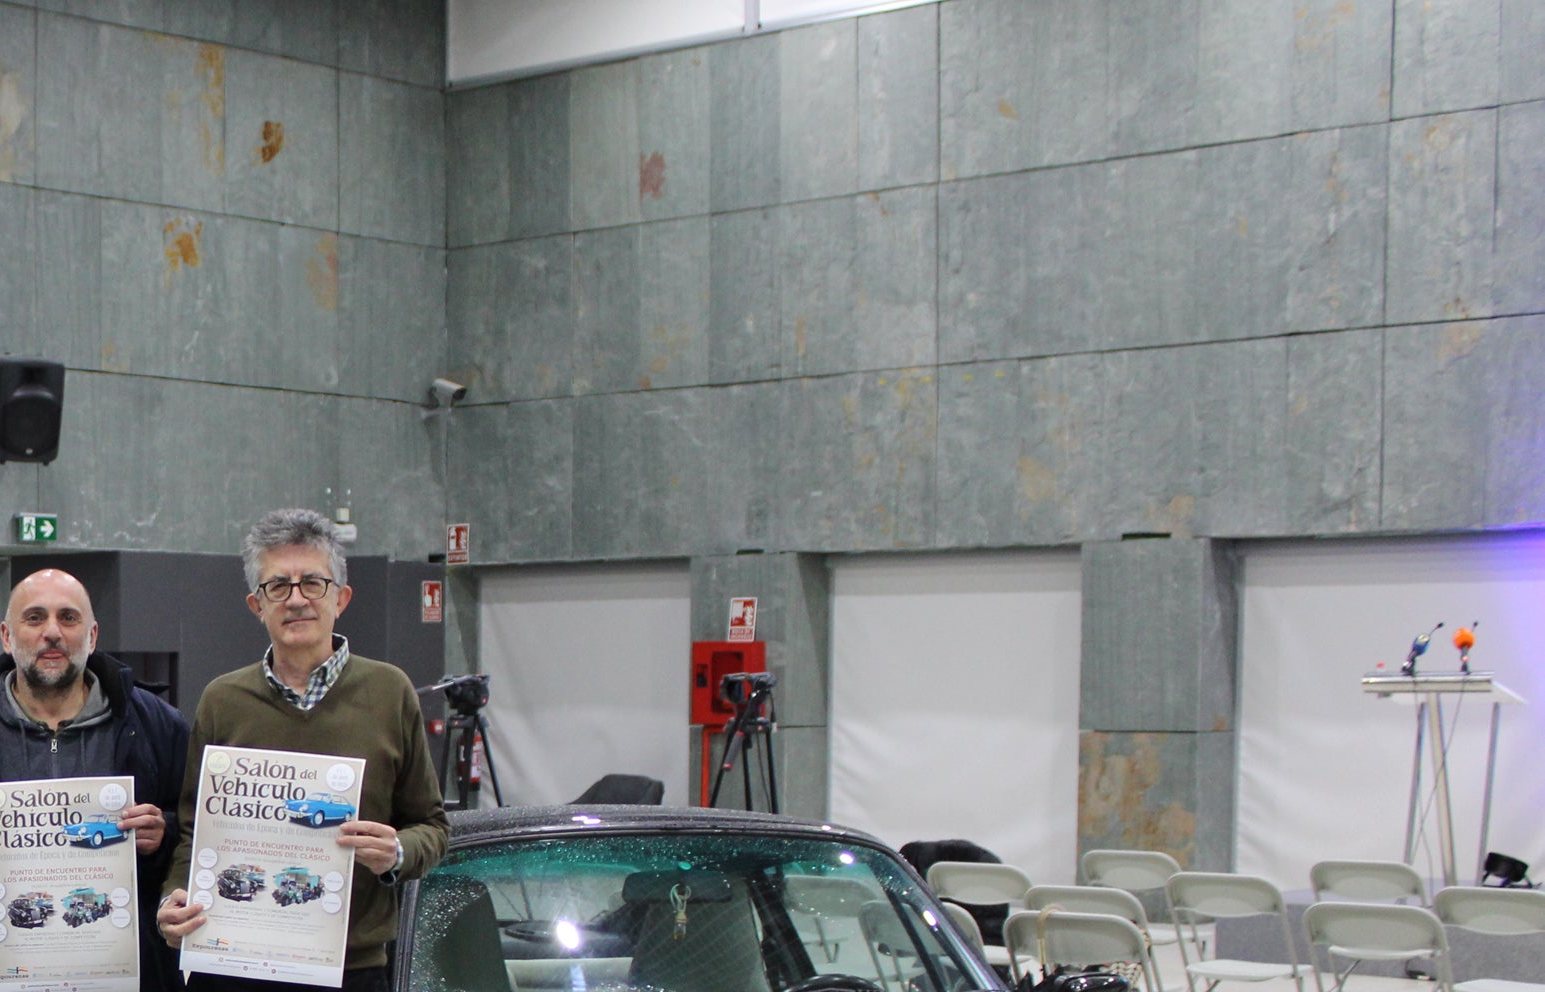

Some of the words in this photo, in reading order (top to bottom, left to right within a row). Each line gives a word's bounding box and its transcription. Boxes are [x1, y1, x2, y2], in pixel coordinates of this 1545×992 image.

[235, 757, 296, 780] Salón
[299, 769, 317, 780] del
[210, 775, 305, 800] Vehículo
[11, 788, 71, 808] Salón
[73, 793, 90, 804] del
[205, 796, 287, 821] Clásico
[225, 838, 248, 846] PUNTO
[261, 842, 303, 851] ENCUENTRO
[233, 848, 283, 858] APASIONADOS
[19, 874, 67, 882] APASIONADOS
